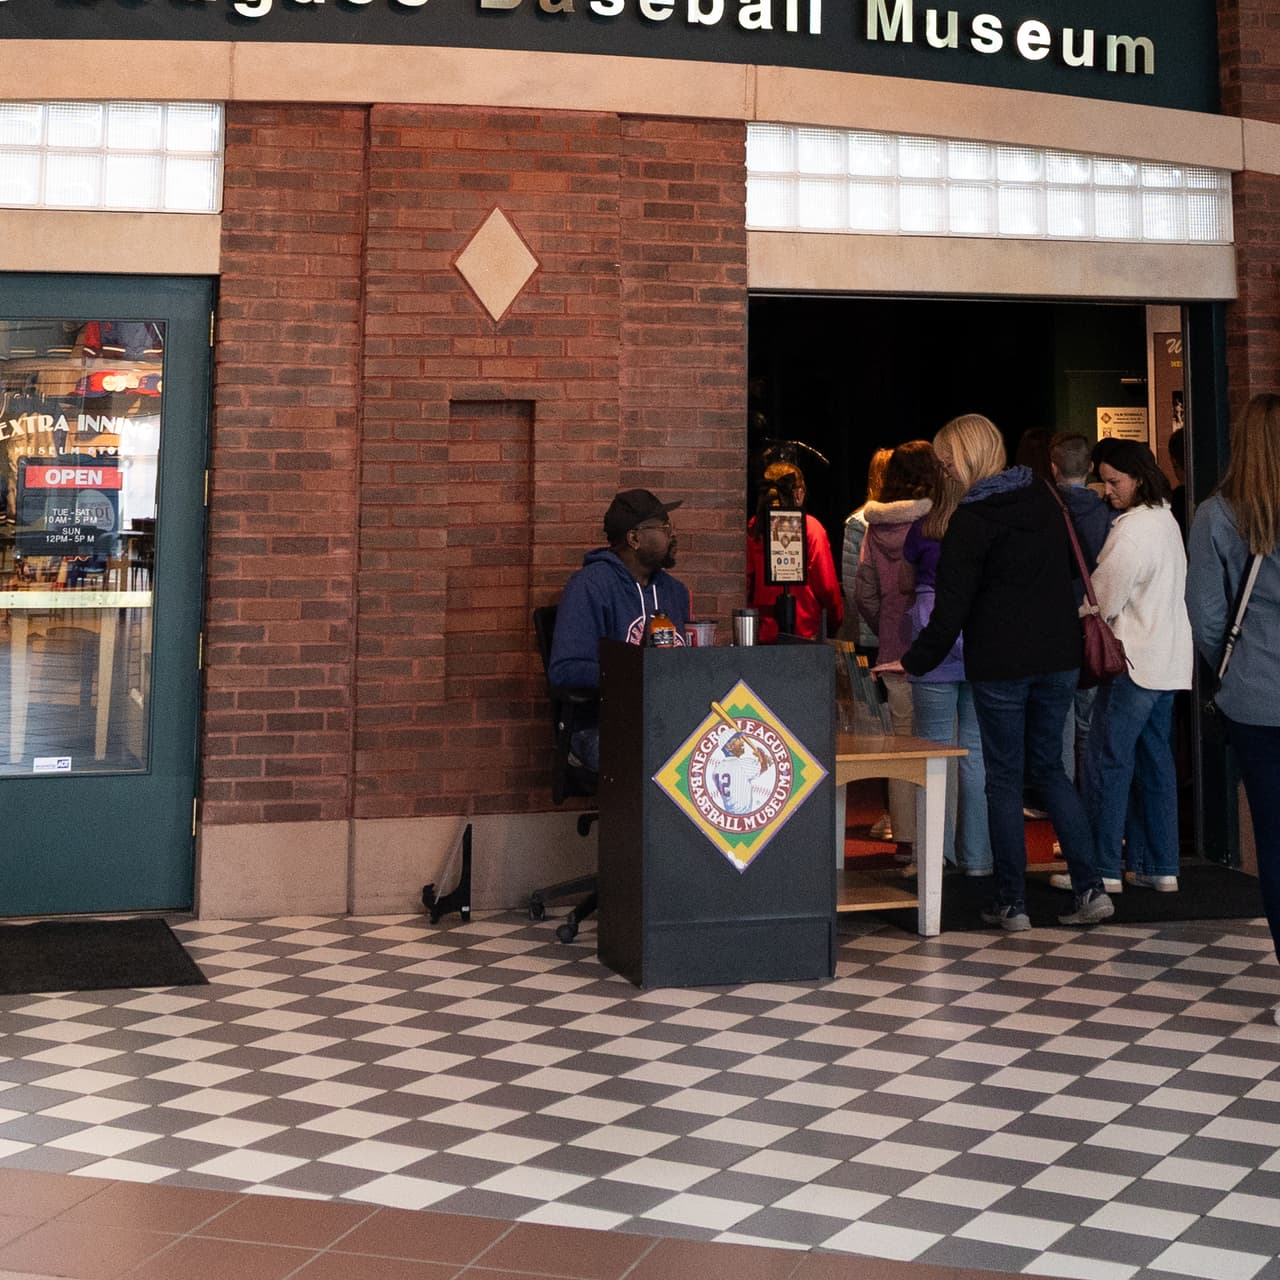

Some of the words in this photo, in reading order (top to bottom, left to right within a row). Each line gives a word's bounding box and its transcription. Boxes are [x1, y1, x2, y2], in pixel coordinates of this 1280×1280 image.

[15, 446, 80, 455] MUSEUM
[44, 469, 102, 485] OPEN
[62, 527, 80, 535] SUN
[737, 720, 790, 771] LEAGUES
[690, 776, 742, 831] BASEBALL
[745, 775, 791, 831] MUSEUM
